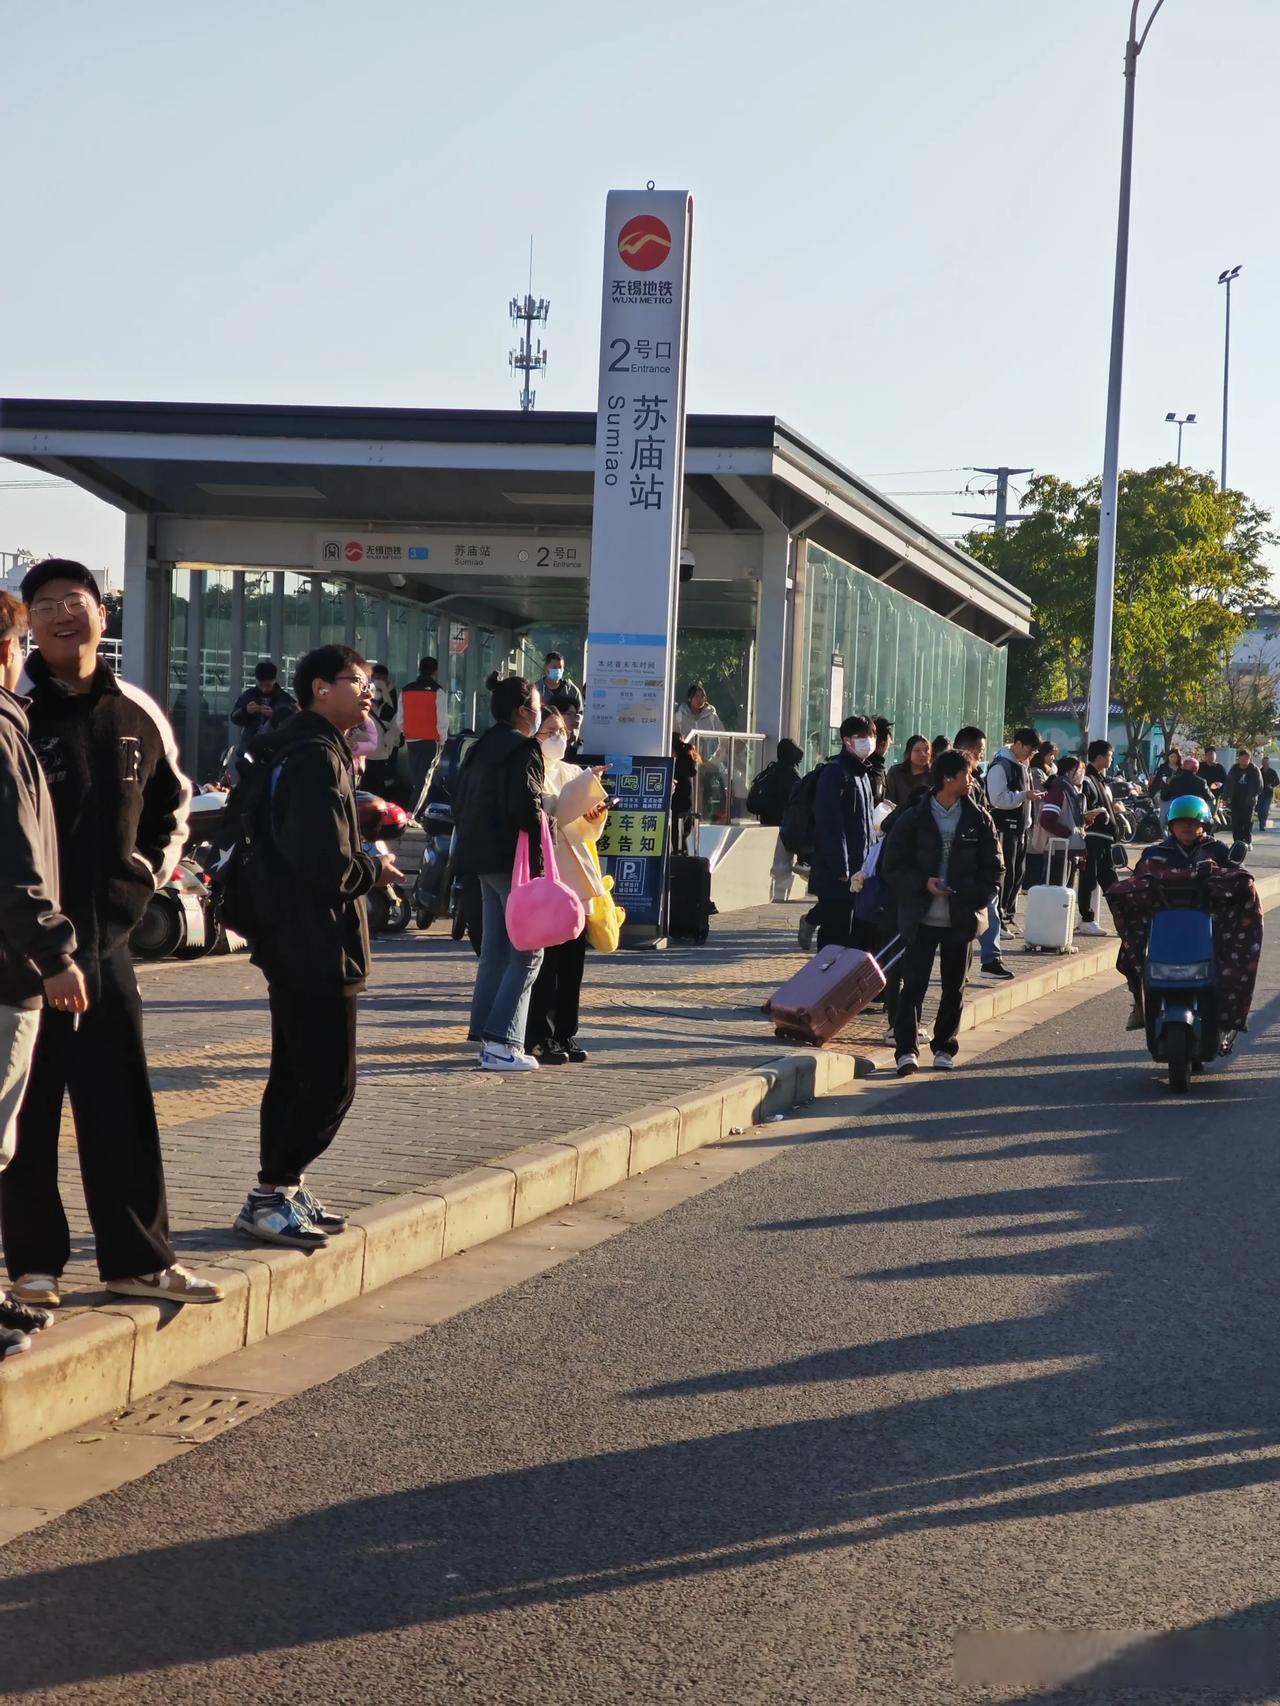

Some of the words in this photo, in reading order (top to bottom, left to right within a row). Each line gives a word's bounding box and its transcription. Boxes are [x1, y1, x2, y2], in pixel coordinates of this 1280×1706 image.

[611, 280, 673, 297] 无锡地铁
[611, 296, 638, 304] WUXI
[639, 297, 673, 305] METRO
[631, 363, 671, 374] Entrance
[605, 395, 625, 486] Sumiao
[629, 395, 668, 510] 苏庙站
[366, 545, 401, 556] 无锡地铁
[454, 544, 491, 557] 苏庙站
[454, 558, 484, 566] Sumiao
